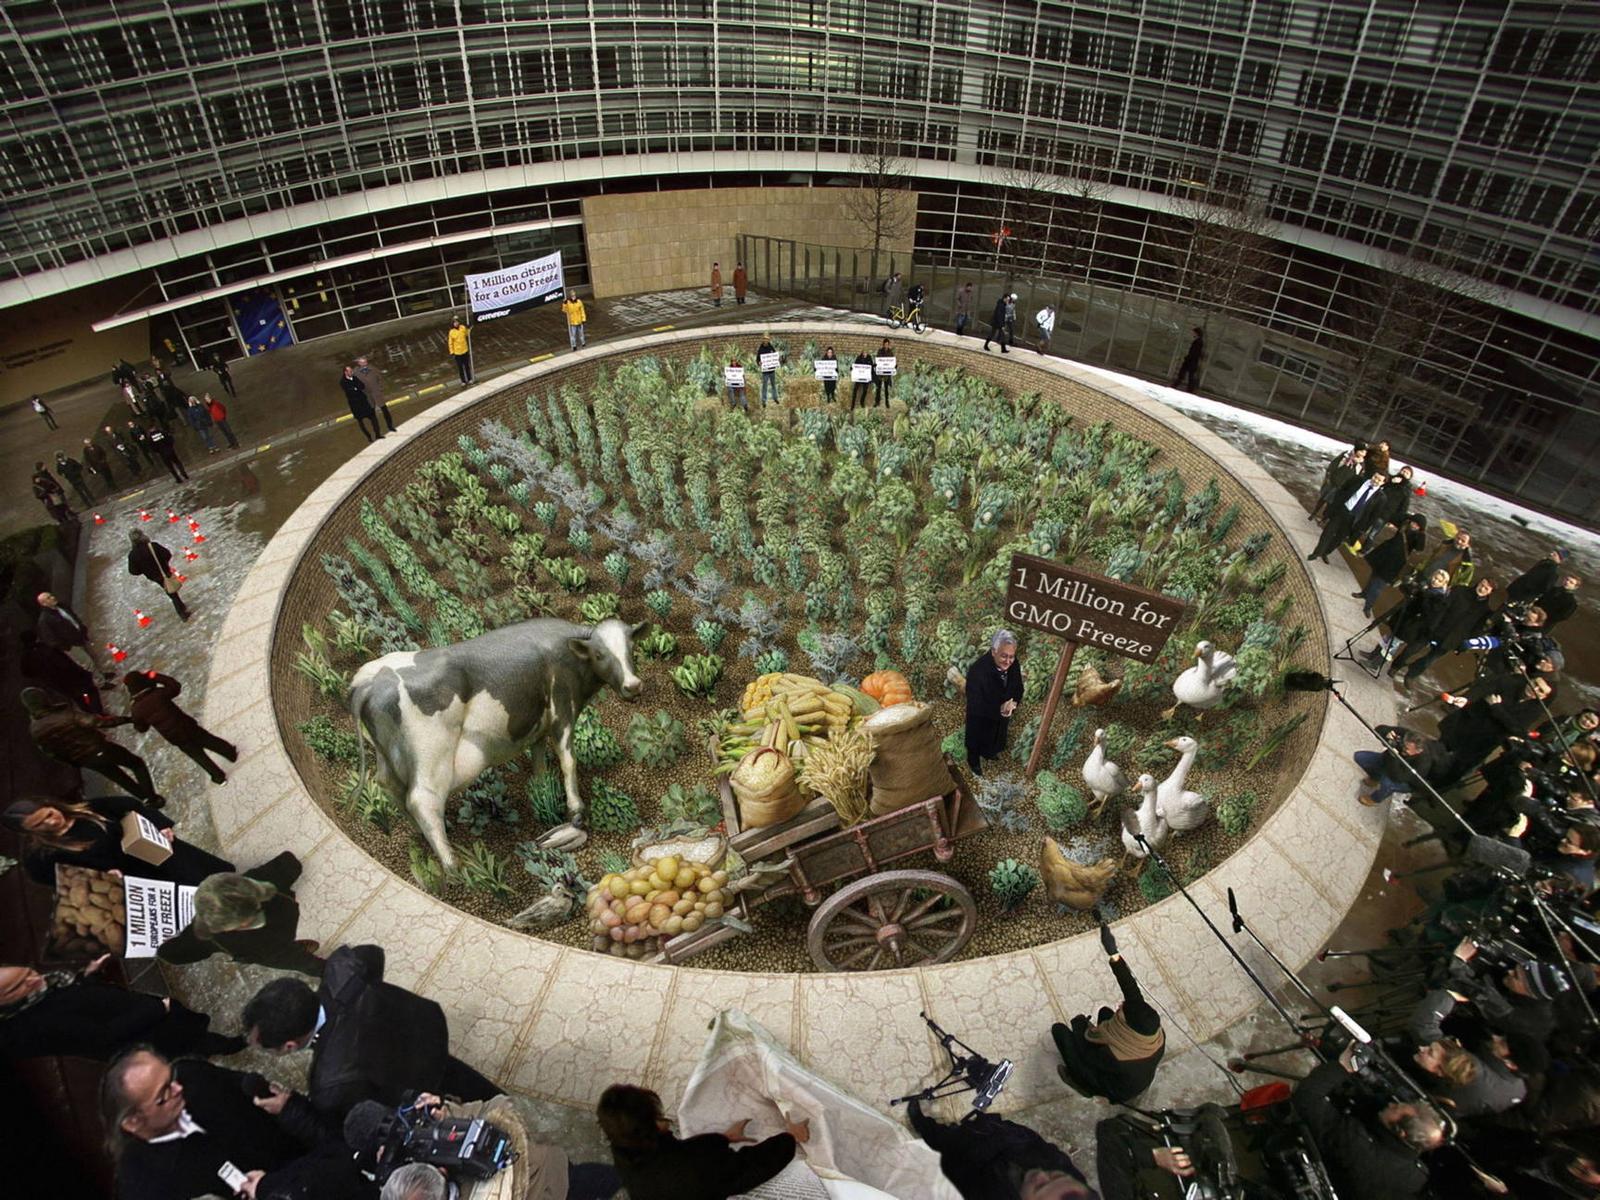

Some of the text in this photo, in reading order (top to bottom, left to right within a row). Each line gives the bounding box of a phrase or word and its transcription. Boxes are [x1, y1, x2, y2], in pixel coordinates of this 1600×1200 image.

[473, 262, 557, 290] 1 Million citizens
[474, 292, 490, 302] for
[502, 282, 527, 296] GMO
[530, 273, 559, 288] Freeze
[1014, 567, 1171, 629] 1 Million for
[1009, 600, 1153, 657] GMO Freeze
[129, 885, 146, 936] MILLION
[147, 893, 157, 907] FOR
[160, 889, 173, 925] FREEZE
[149, 908, 159, 948] EUROPEANS
